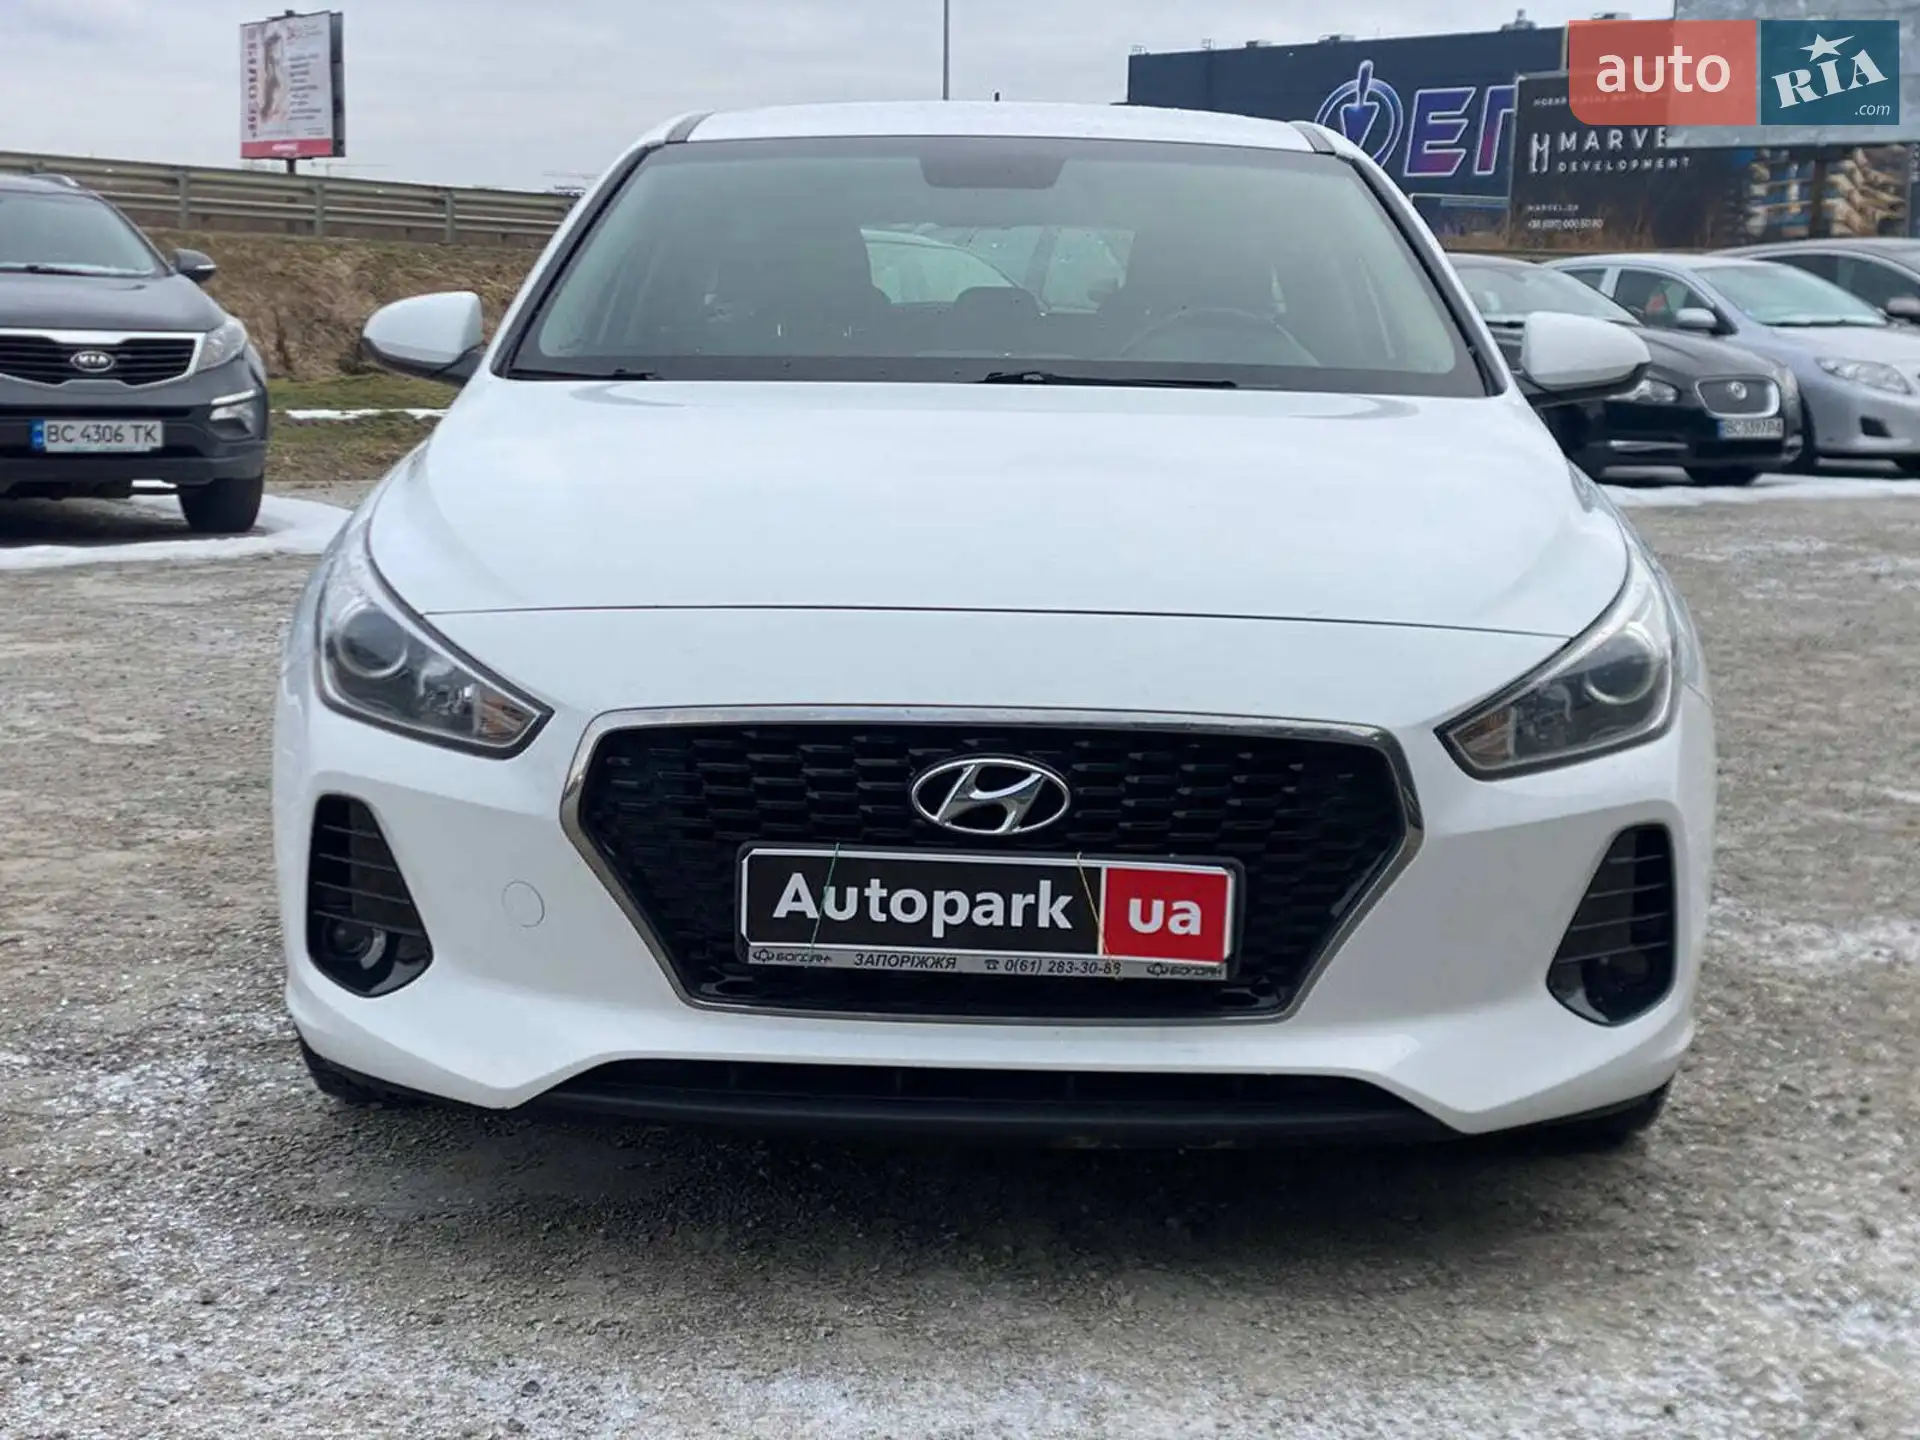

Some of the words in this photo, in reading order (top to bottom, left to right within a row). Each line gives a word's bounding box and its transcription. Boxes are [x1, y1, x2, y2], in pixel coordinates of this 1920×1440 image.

[1557, 157, 1691, 173] DEVELOPMENT
[78, 354, 108, 365] KIA
[46, 424, 75, 443] BC
[80, 424, 125, 443] 4306
[130, 424, 157, 443] TK
[772, 872, 1073, 939] Autopark
[1128, 897, 1202, 937] ua
[852, 952, 957, 970] ЗАПОРІЖЖЯ
[1003, 959, 1042, 974] 0(61)
